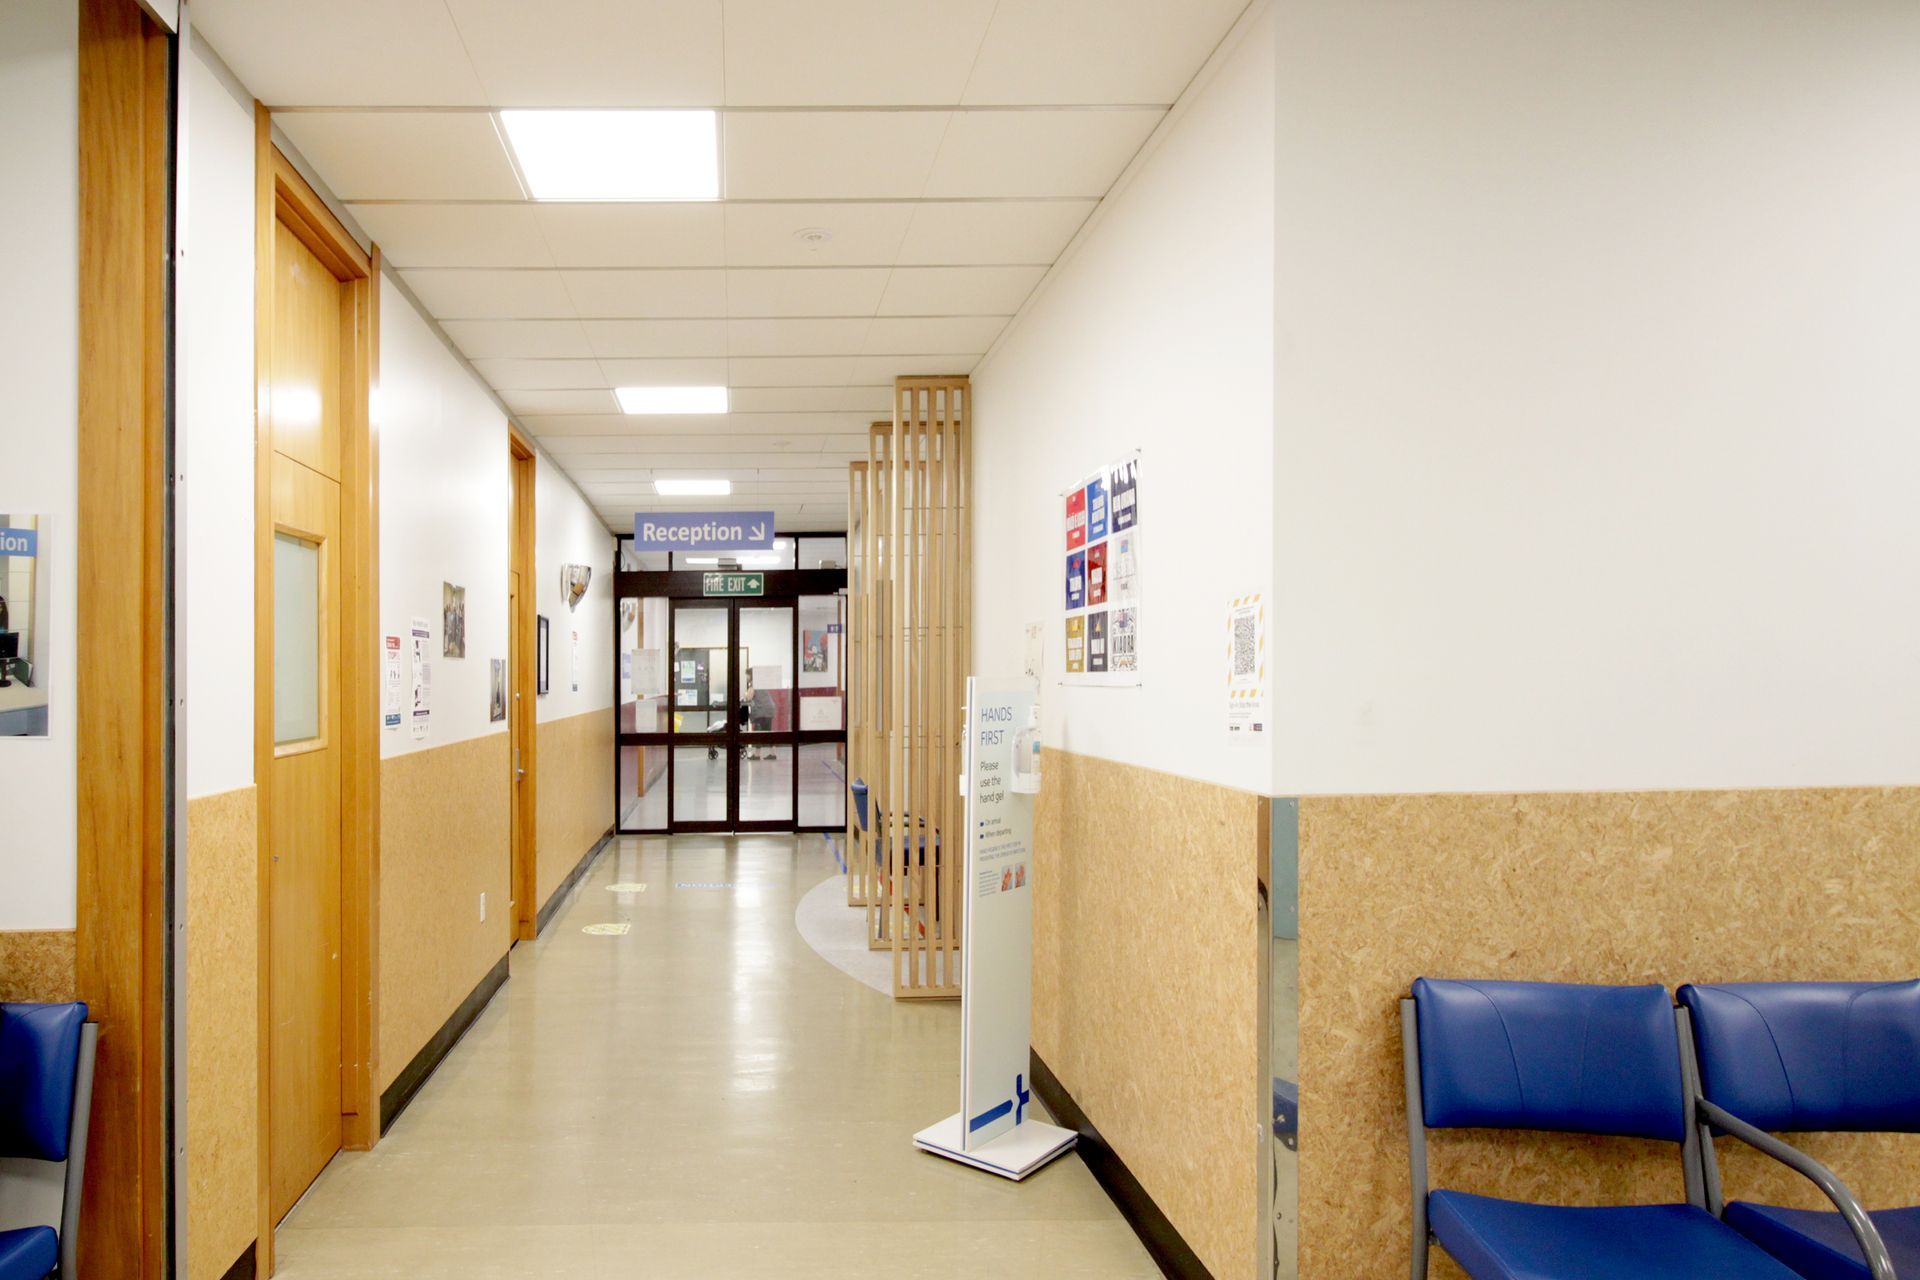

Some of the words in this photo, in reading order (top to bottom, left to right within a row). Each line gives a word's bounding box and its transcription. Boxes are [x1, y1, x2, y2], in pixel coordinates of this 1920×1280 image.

[643, 521, 742, 546] Reception
[705, 576, 724, 593] FIRE
[728, 577, 746, 592] EXIT
[981, 706, 1012, 722] HANDS
[981, 729, 1004, 746] FIRST
[980, 761, 999, 771] Please
[980, 778, 991, 788] use
[991, 775, 1001, 786] the
[980, 790, 995, 804] hand
[995, 789, 1004, 804] gel
